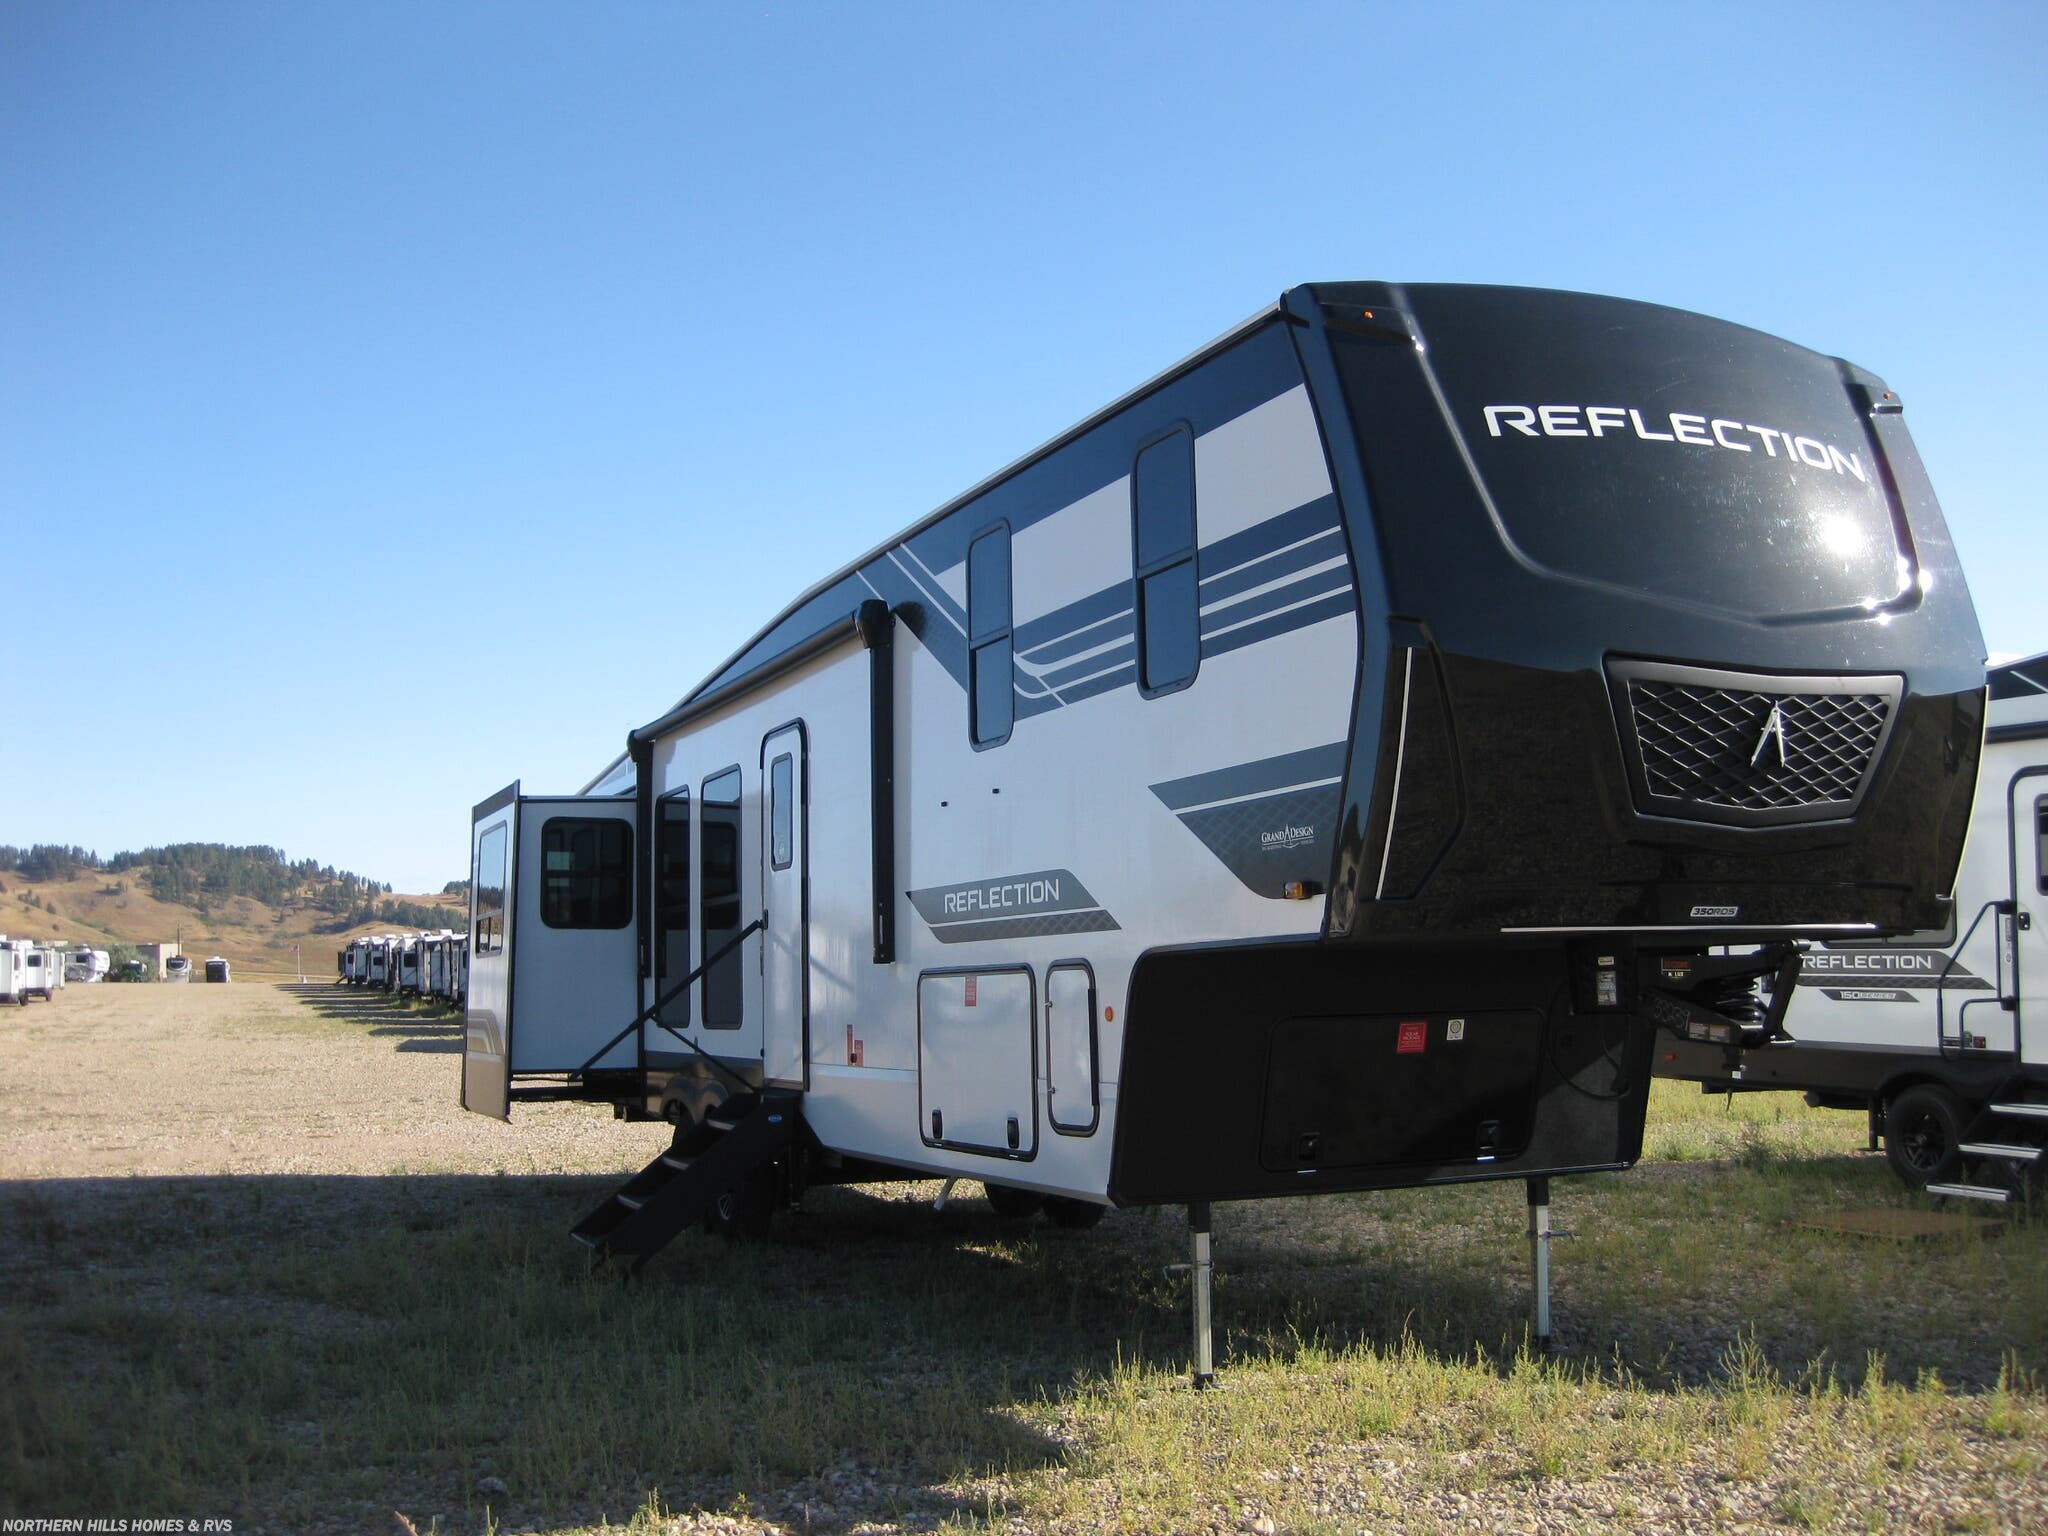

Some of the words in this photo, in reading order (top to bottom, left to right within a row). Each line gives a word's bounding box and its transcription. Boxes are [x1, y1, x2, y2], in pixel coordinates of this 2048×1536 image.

[1483, 405, 1867, 483] REFLECTION
[1261, 830, 1284, 843] GRAND
[1290, 825, 1314, 838] DESIGN
[944, 879, 1060, 914] REFLECTION
[1802, 955, 1932, 969] REFLECTION
